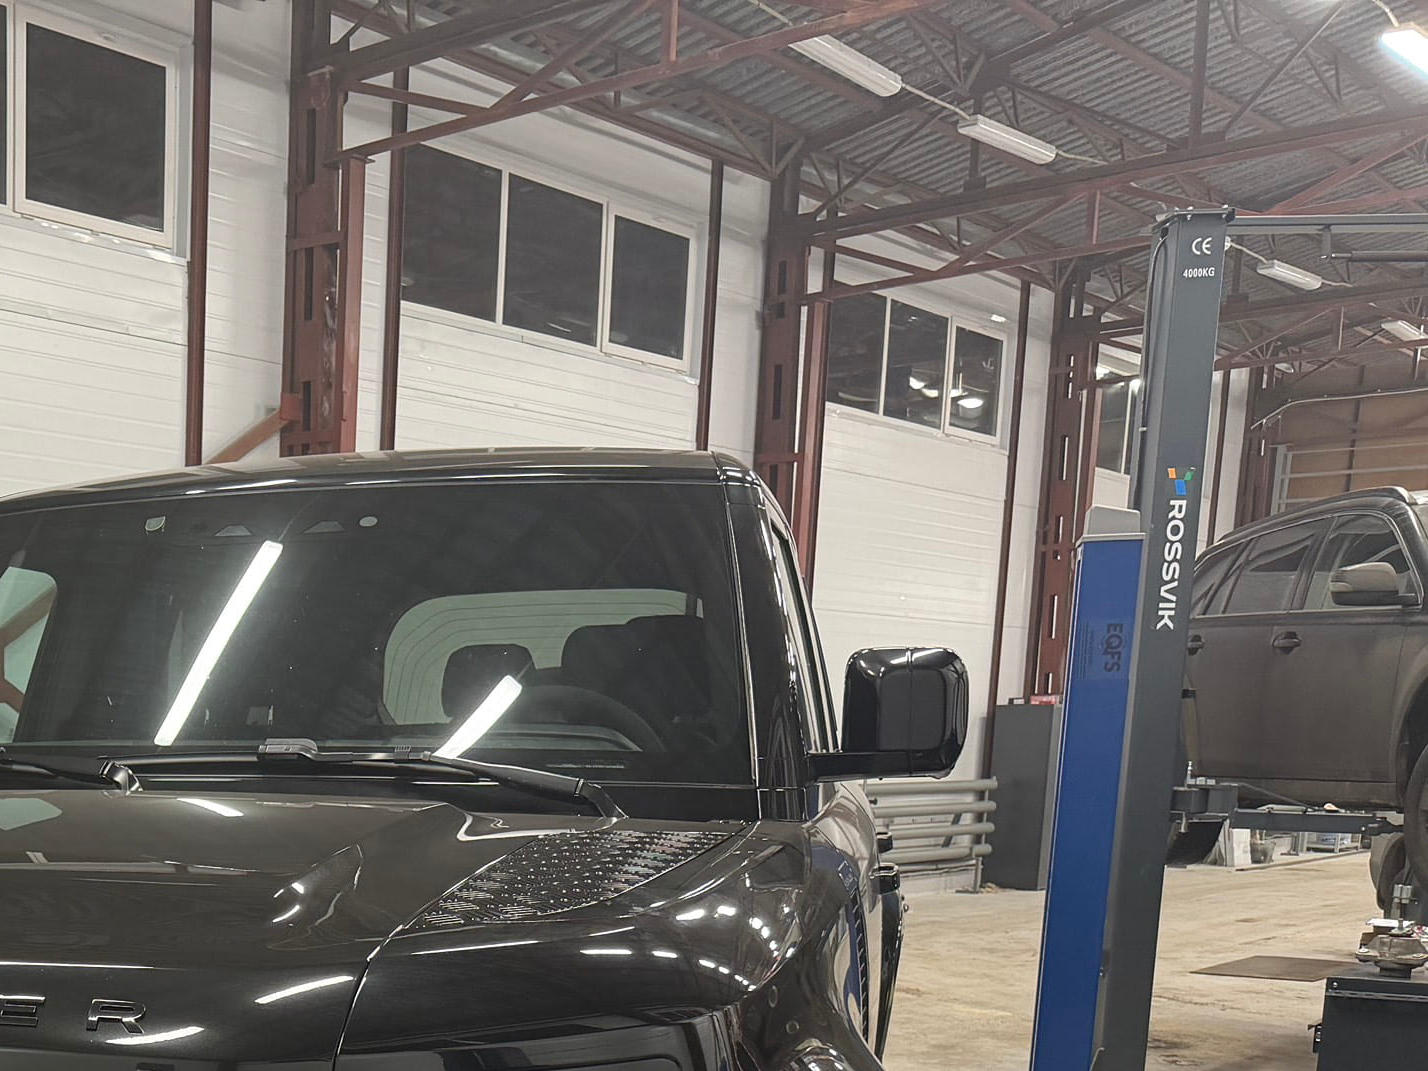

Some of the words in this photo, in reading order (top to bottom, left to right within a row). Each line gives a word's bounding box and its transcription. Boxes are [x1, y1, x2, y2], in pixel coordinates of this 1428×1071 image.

[1191, 237, 1213, 255] CE
[1183, 266, 1215, 279] 4000KG
[1156, 499, 1188, 631] ROSSVIK
[1103, 623, 1124, 672] EQFS
